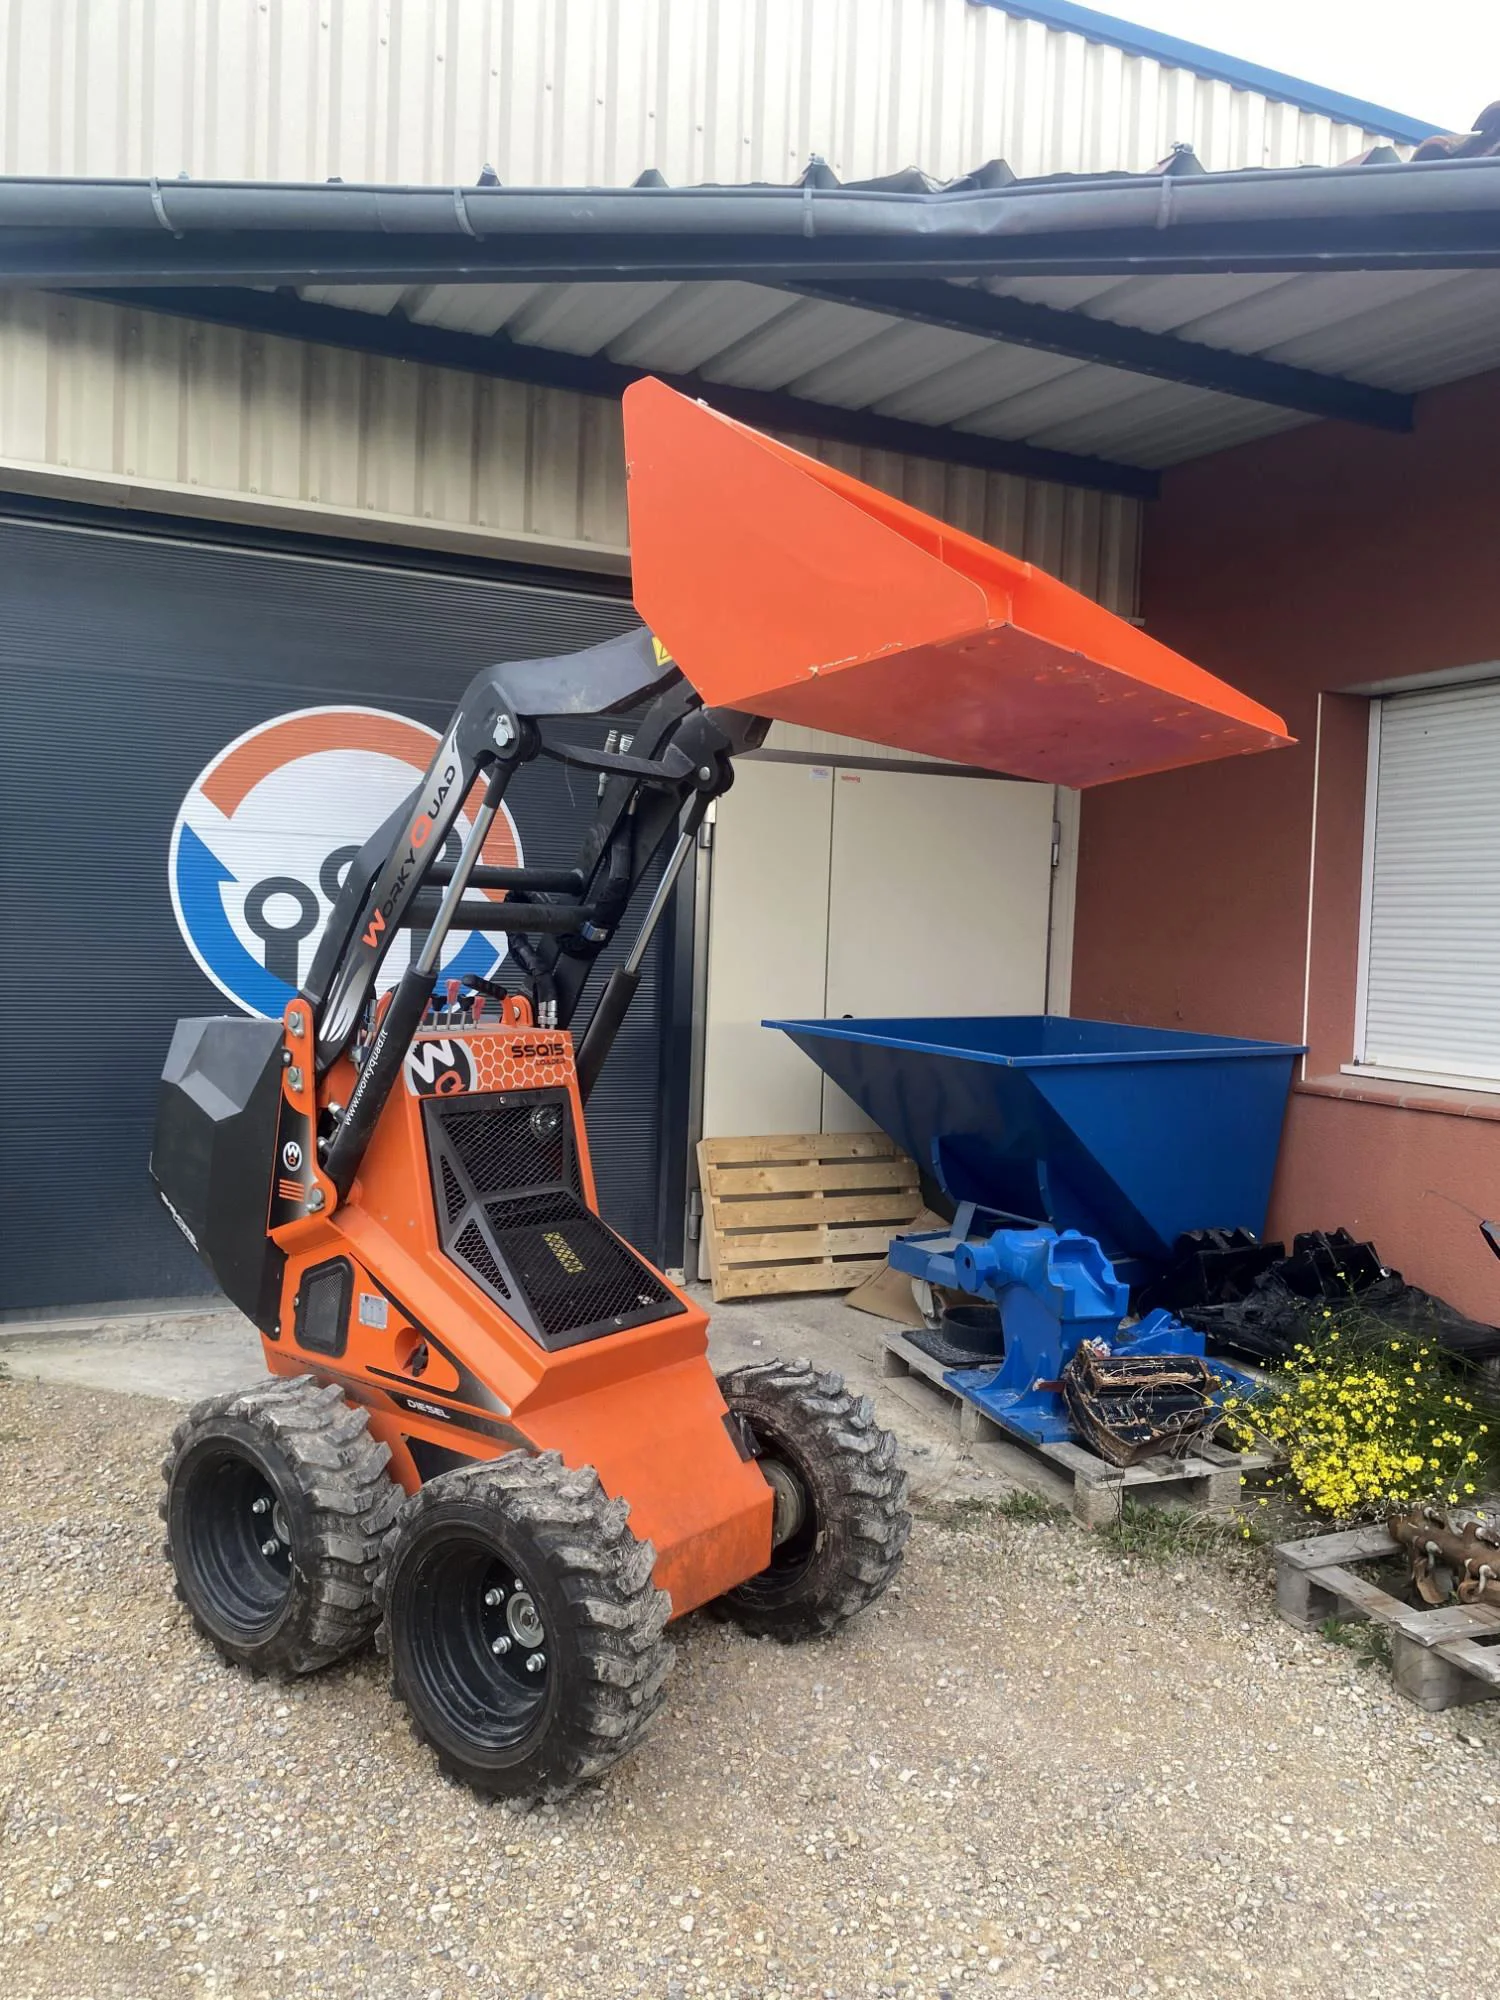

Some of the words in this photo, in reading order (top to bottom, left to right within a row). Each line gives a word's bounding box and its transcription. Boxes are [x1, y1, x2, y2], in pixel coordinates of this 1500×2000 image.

[511, 1043, 565, 1058] SSQ15
[344, 1029, 389, 1126] www.workyquad.it
[406, 1399, 452, 1419] DIESEL
